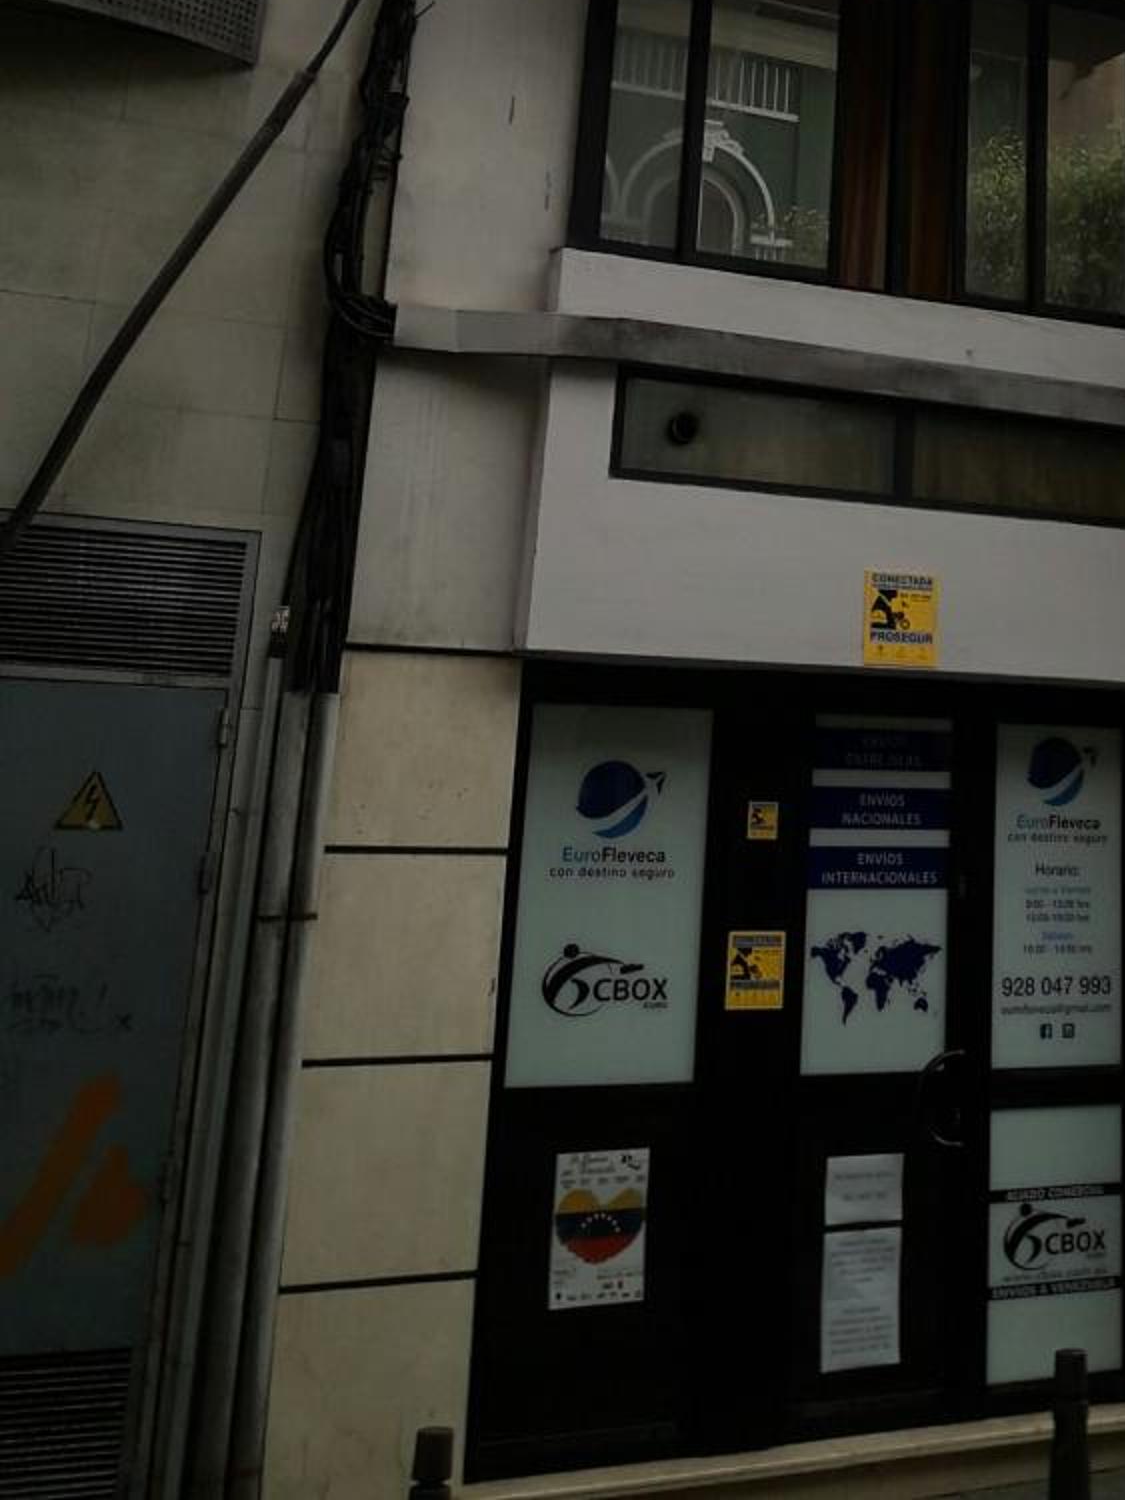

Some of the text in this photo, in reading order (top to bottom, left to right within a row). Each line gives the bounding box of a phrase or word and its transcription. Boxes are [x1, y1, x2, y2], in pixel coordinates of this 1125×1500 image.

[870, 630, 933, 644] PROSEGUR
[841, 812, 923, 826] NACIONALES
[1016, 814, 1101, 830] EuroFleveca
[562, 847, 666, 864] EuroFleveca
[549, 867, 675, 882] con destino seguro
[821, 870, 939, 885] INTERNACIONALES
[593, 978, 668, 1001] CBOX
[1001, 975, 1112, 997] 928 047 993
[1045, 1230, 1105, 1255] CBOX
